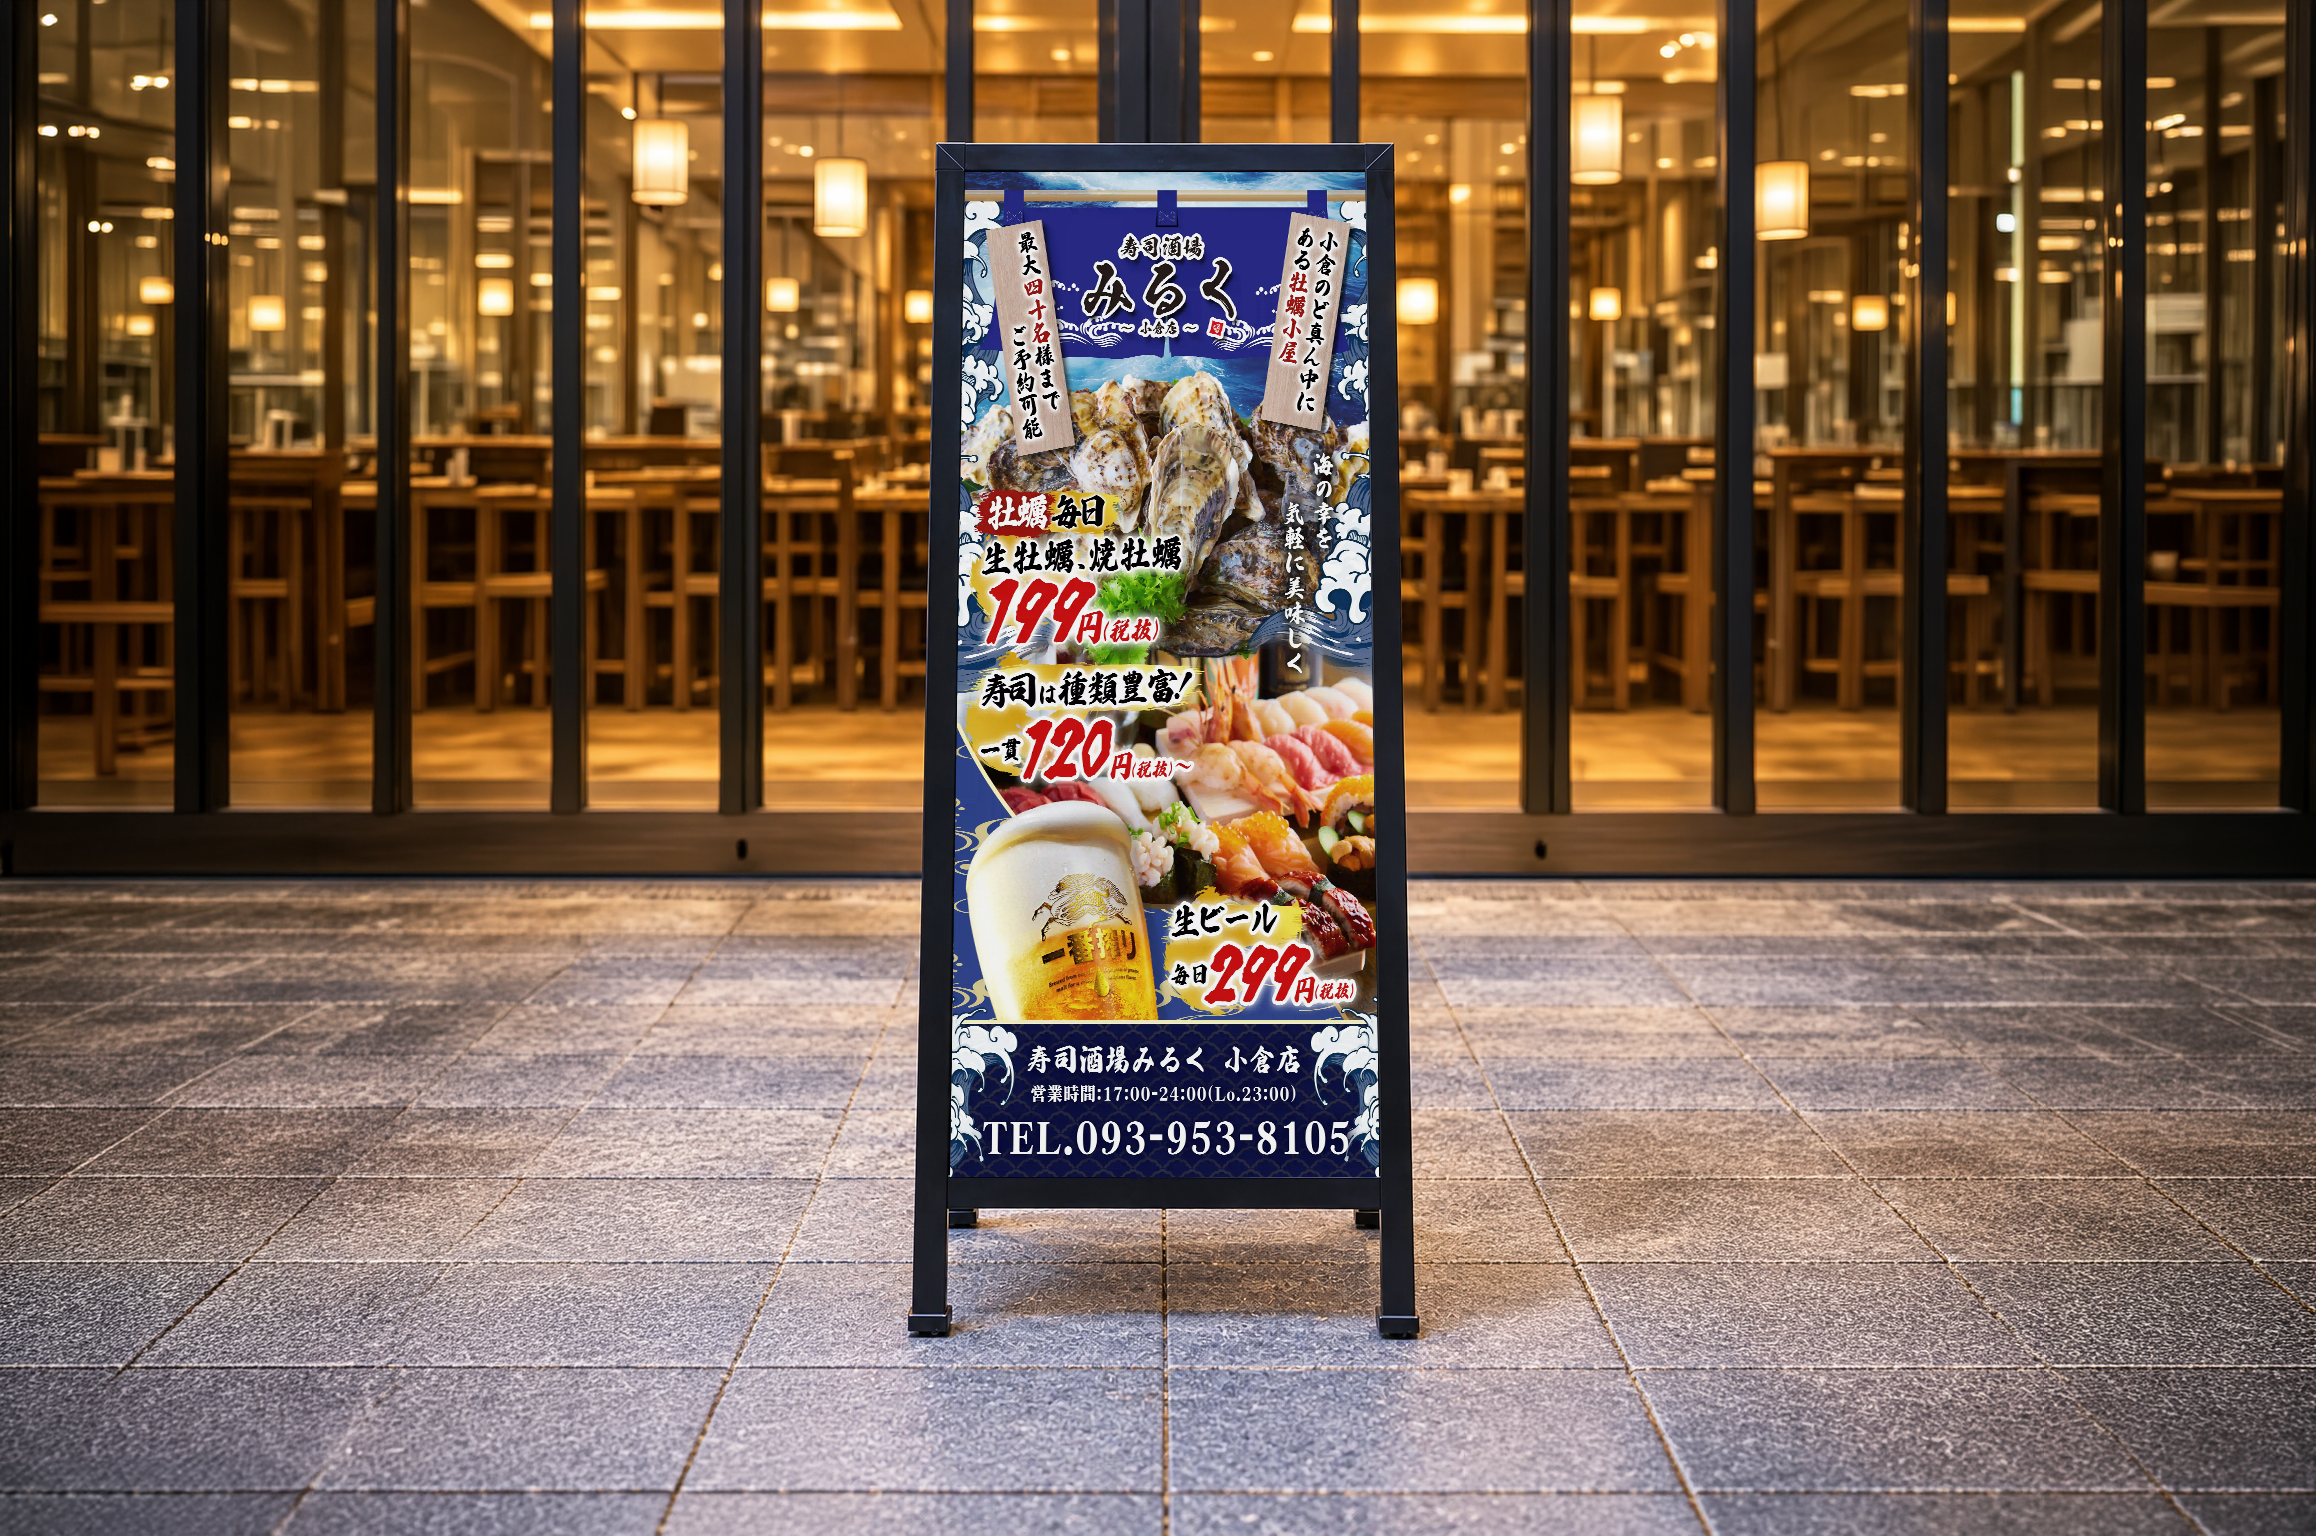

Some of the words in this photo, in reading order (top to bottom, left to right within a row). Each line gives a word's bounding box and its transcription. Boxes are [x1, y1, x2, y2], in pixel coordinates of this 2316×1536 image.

[1119, 235, 1203, 259] 寿司酒場
[1083, 259, 1235, 319] みるく
[1278, 227, 1314, 365] ある牡蠣小屋
[1018, 231, 1061, 410] 最大四十名様まで
[1296, 231, 1339, 412] 小倉のど真ん中に
[1013, 325, 1043, 440] ご予約可能
[1313, 452, 1334, 549] 海の幸を
[981, 535, 1183, 576] 生牡蠣、焼牡蠣
[1284, 501, 1306, 674] 気軽に美味しく
[981, 668, 1194, 709] 寿司は種類豊富!
[1171, 902, 1278, 937] 生ビール
[1027, 1045, 1205, 1074] 寿司酒場みるく
[1224, 1045, 1301, 1074] 小倉店
[982, 1120, 1350, 1156] TEL.093-953-8105
